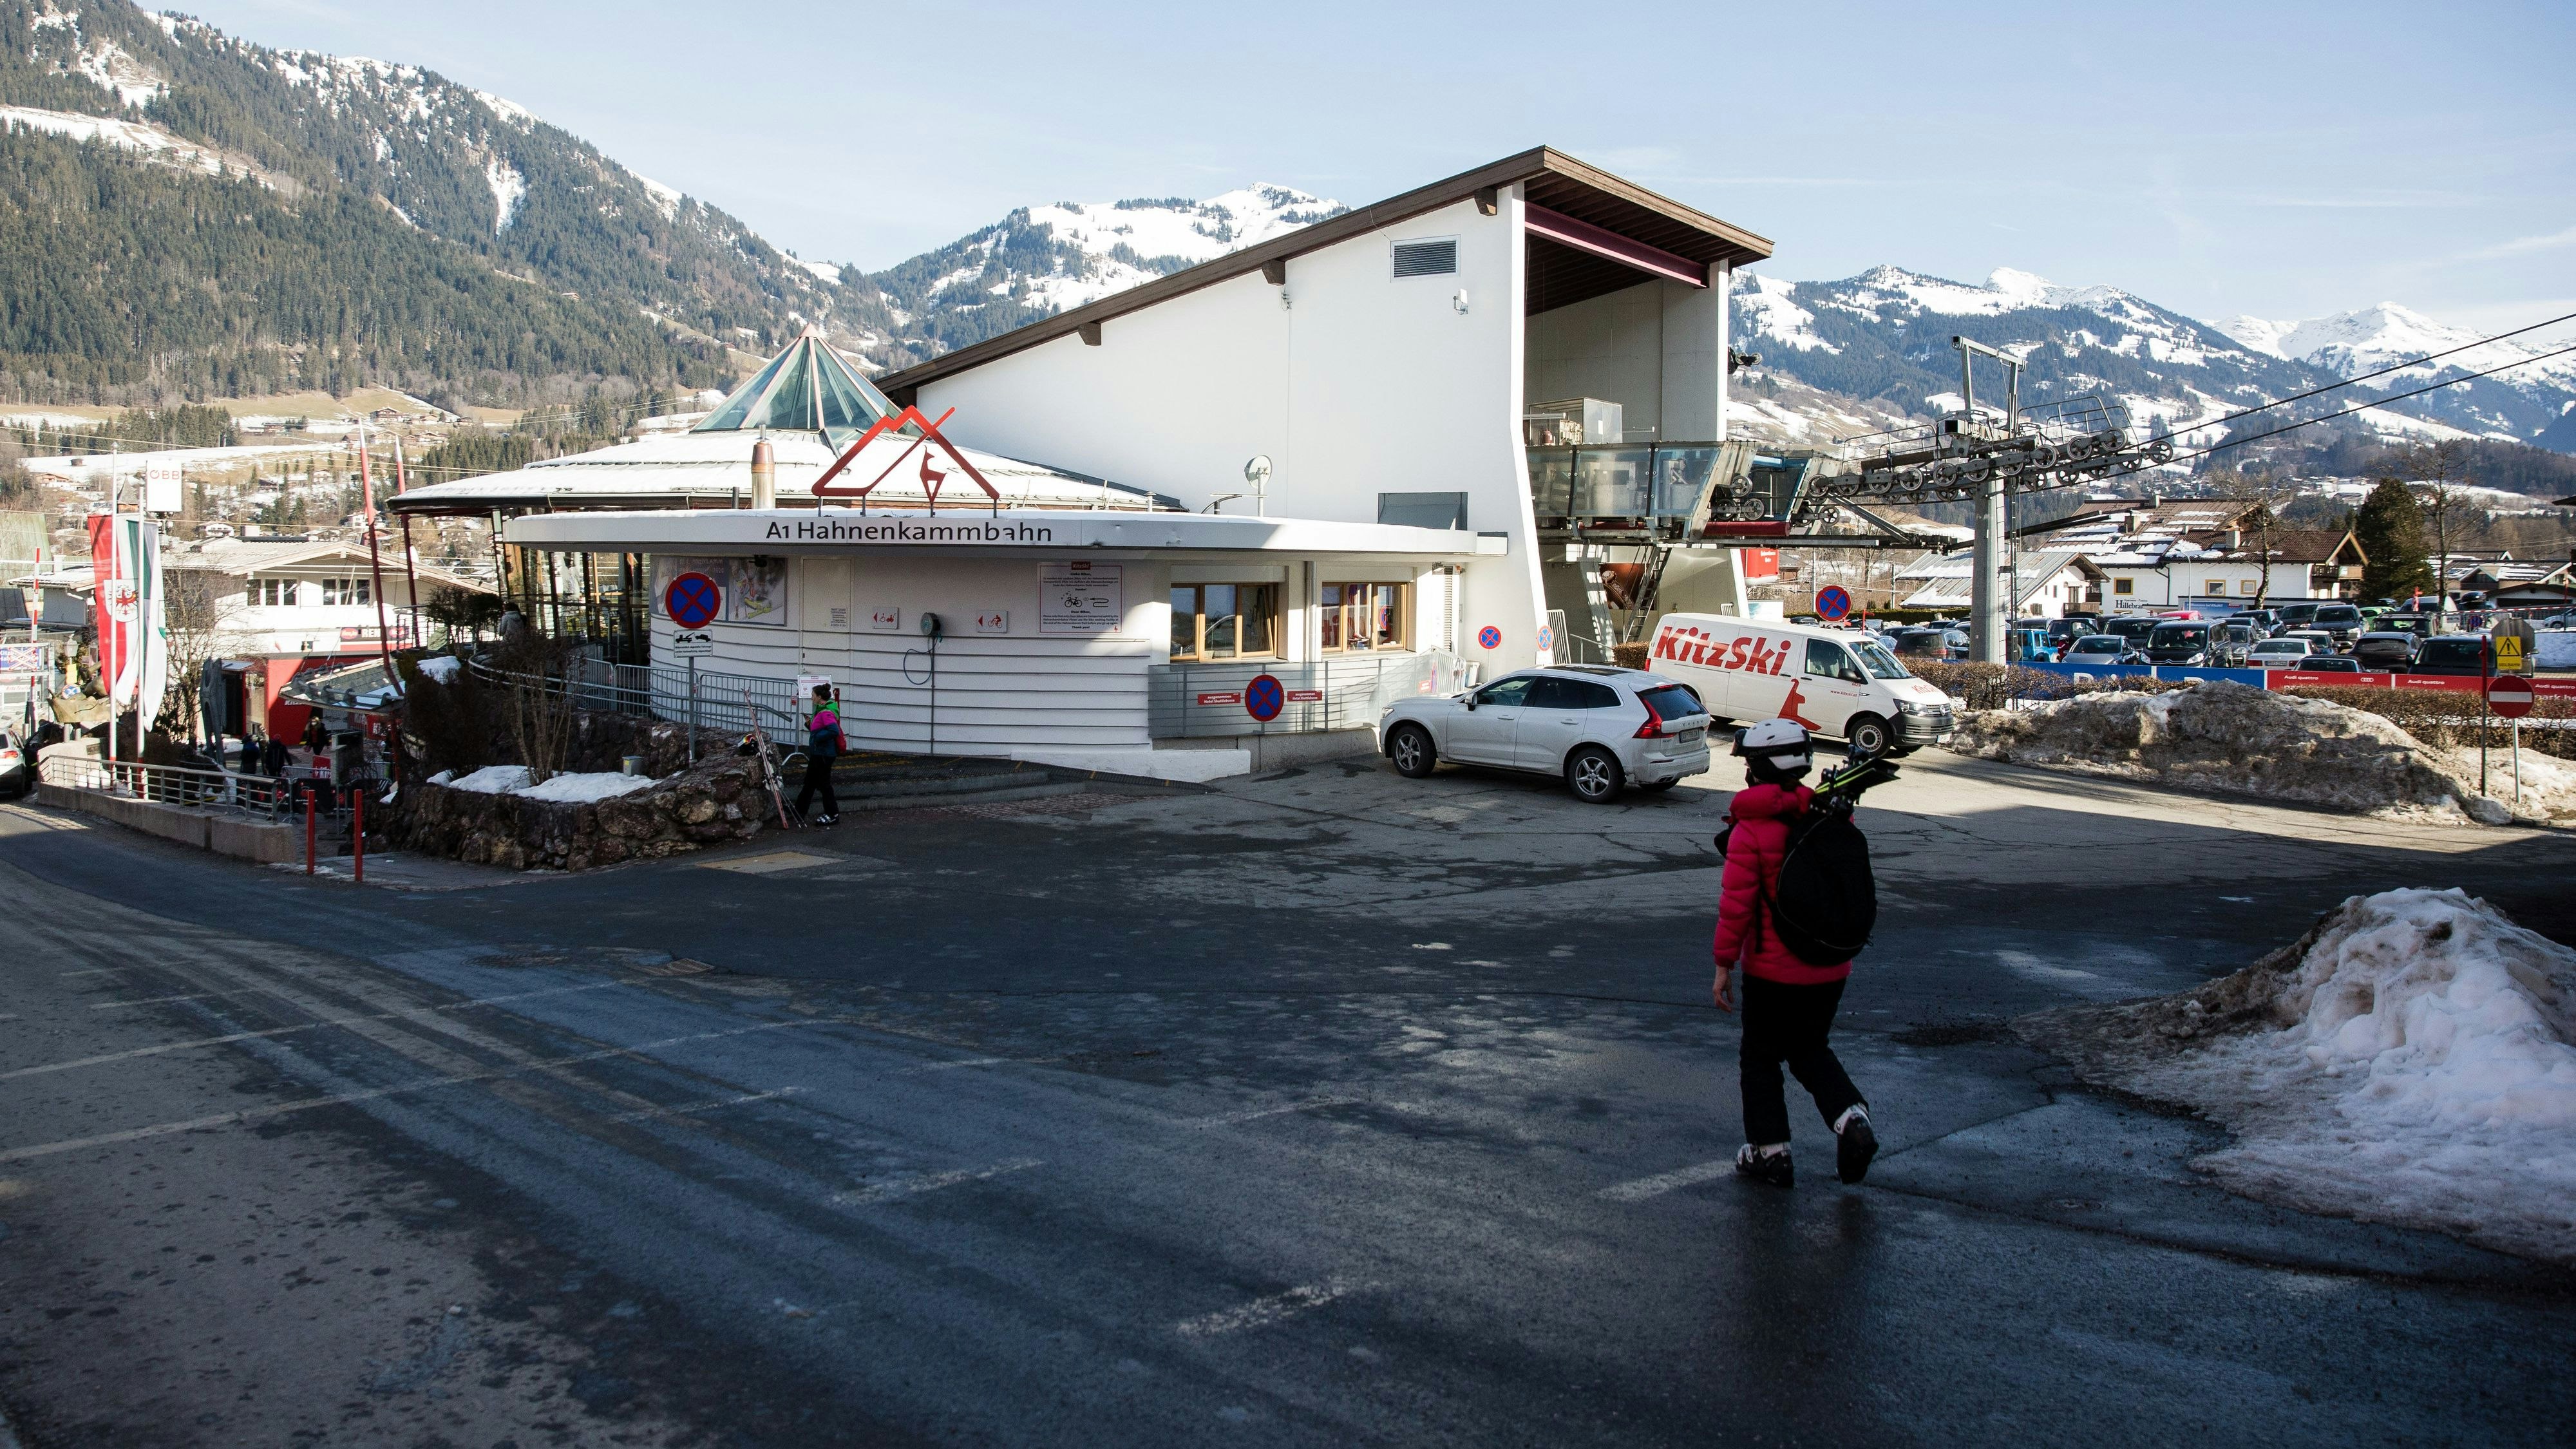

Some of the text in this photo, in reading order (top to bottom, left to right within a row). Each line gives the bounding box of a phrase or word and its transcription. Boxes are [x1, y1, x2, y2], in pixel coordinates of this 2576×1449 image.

[149, 469, 180, 480] ÖBB
[766, 522, 790, 539] A1
[1653, 625, 1792, 676] KitzSki
